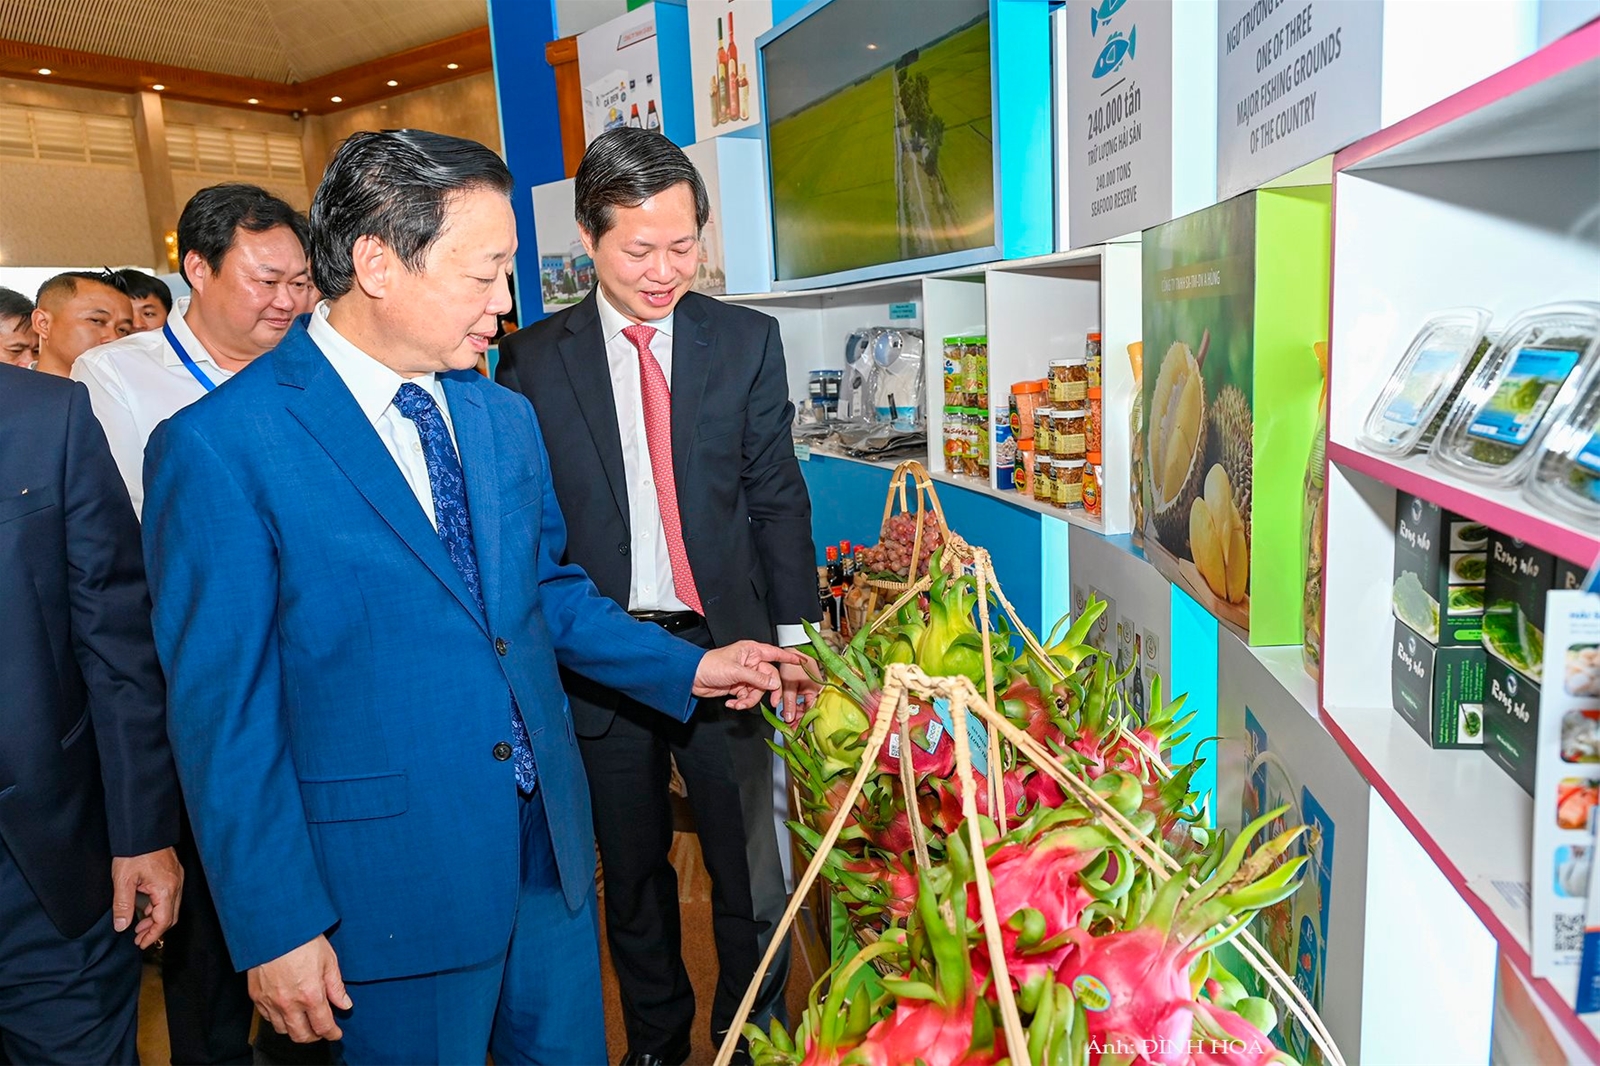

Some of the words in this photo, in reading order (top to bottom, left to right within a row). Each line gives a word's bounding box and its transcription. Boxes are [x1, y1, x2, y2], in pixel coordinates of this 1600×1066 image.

[1256, 38, 1272, 73] ONE
[1273, 28, 1284, 60] OF
[1285, 3, 1312, 50] THREE
[1237, 89, 1259, 126] MAJOR
[1260, 64, 1292, 110] FISHING
[1293, 26, 1342, 87] GROUNDS
[1088, 94, 1122, 140] 240.000
[1124, 81, 1141, 118] tấn
[1250, 126, 1259, 155] OF
[1261, 118, 1274, 149] THE
[1275, 91, 1317, 141] COUNTRY
[1116, 161, 1132, 183] TONS
[1091, 195, 1114, 218] SEAFOOD
[1114, 185, 1137, 210] RESERVE
[1494, 541, 1517, 574] Rong
[1519, 556, 1540, 577] nho
[1491, 679, 1512, 714] Rong
